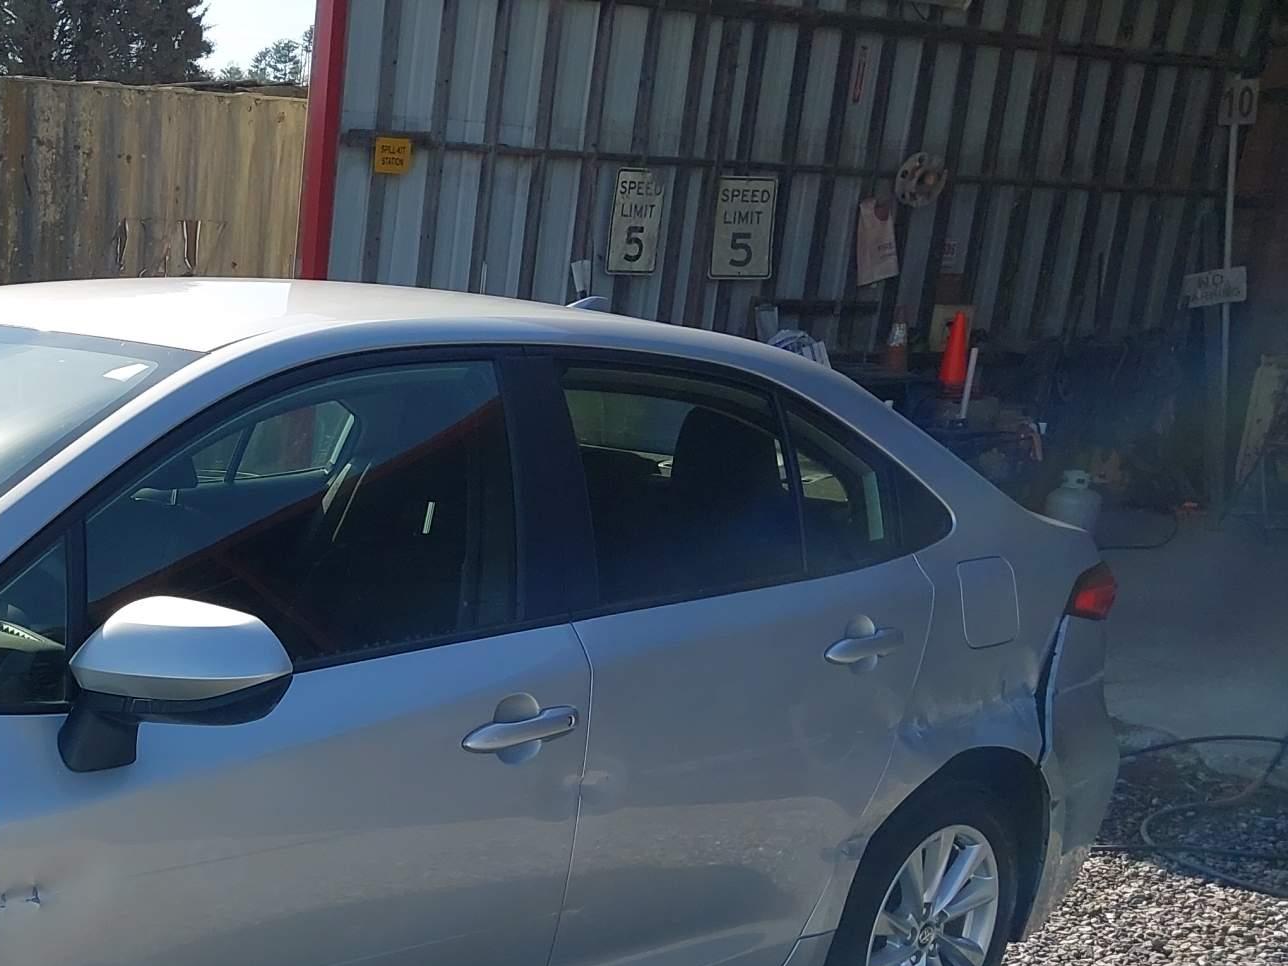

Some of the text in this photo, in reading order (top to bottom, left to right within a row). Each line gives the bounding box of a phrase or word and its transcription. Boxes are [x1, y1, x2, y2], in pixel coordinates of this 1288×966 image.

[1224, 86, 1254, 118] 10
[720, 188, 771, 203] SPEED
[620, 203, 657, 219] LIMIT
[723, 210, 764, 225] LIMIT
[623, 226, 645, 262] 5
[729, 232, 753, 267] 5
